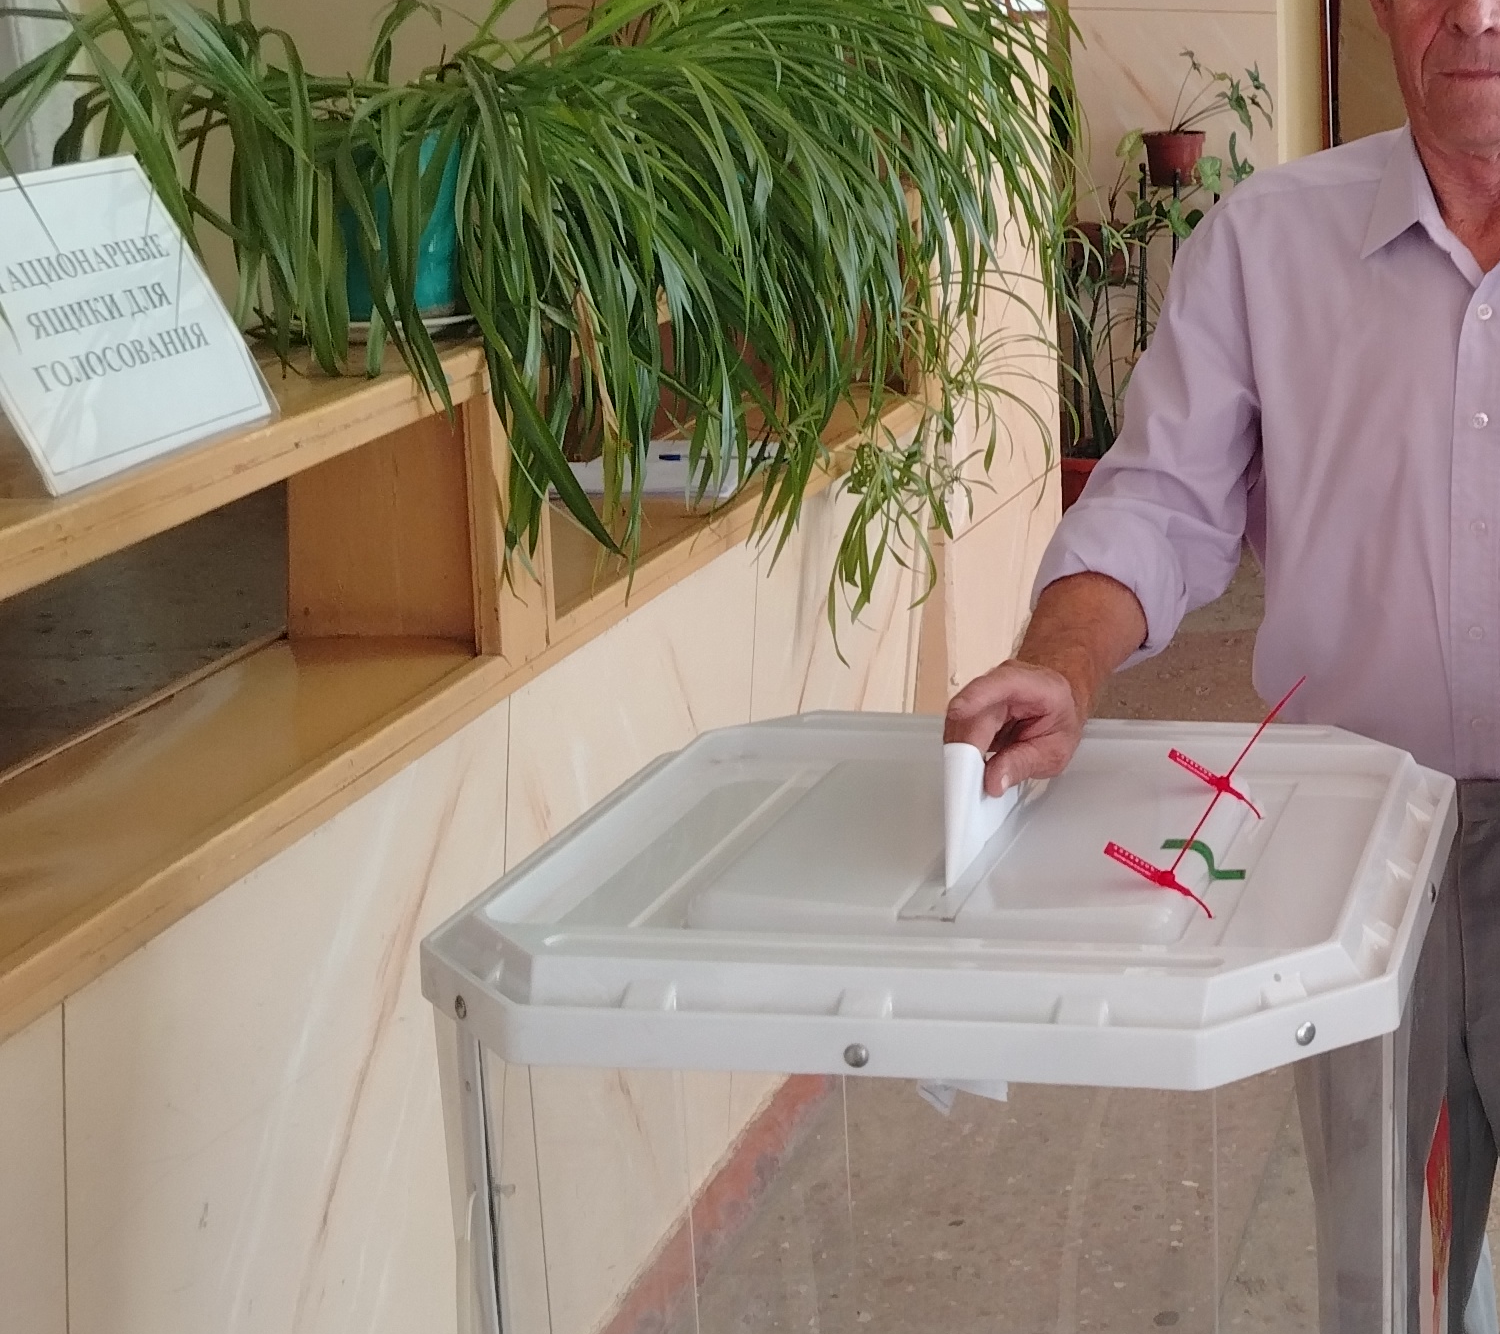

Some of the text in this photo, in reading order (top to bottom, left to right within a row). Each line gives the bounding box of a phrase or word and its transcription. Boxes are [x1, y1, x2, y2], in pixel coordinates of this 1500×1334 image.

[26, 282, 172, 341] ЯЩИКИ ДЛЯ
[32, 322, 211, 393] ГОЛОСОВАНИЯ
